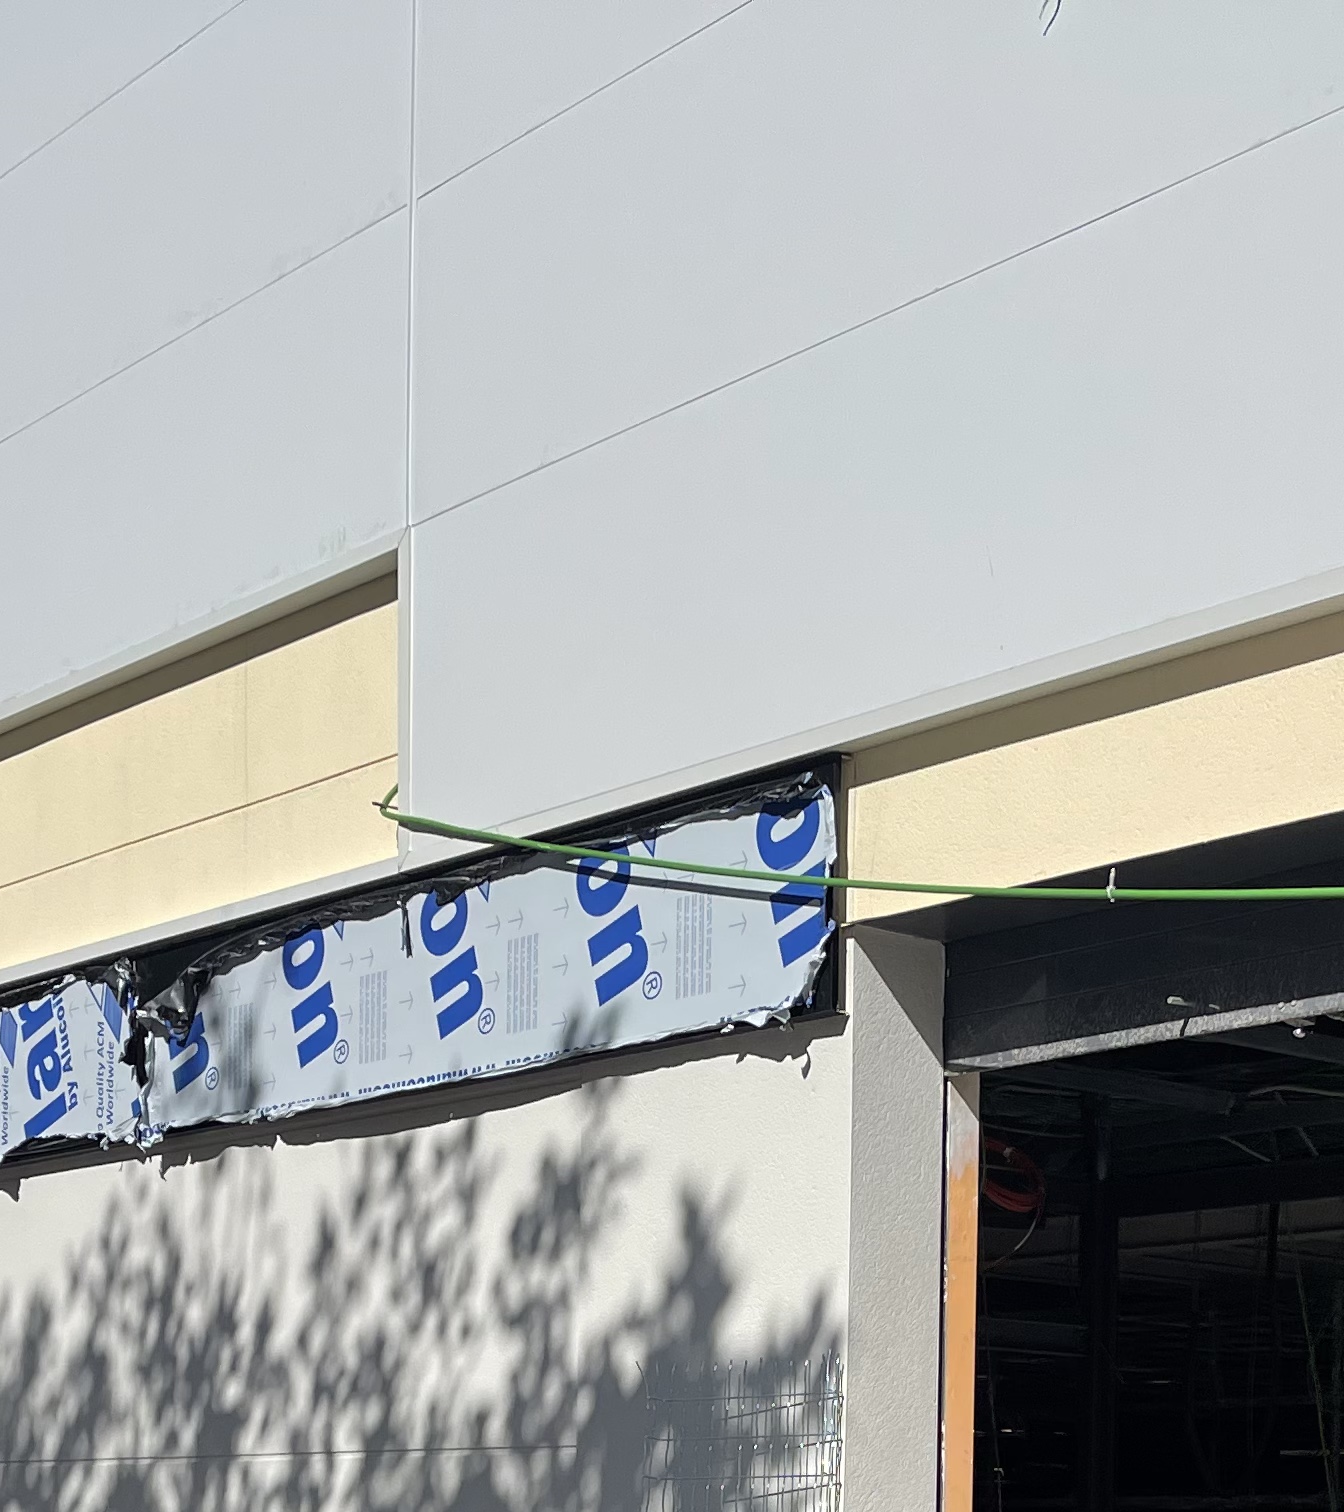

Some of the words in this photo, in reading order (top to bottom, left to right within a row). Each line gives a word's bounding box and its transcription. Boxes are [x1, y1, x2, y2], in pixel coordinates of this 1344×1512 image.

[96, 1020, 105, 1058] ACM
[1, 1066, 9, 1146] Worldwide
[95, 1062, 105, 1118] Quality
[106, 1041, 115, 1126] Worldwide
